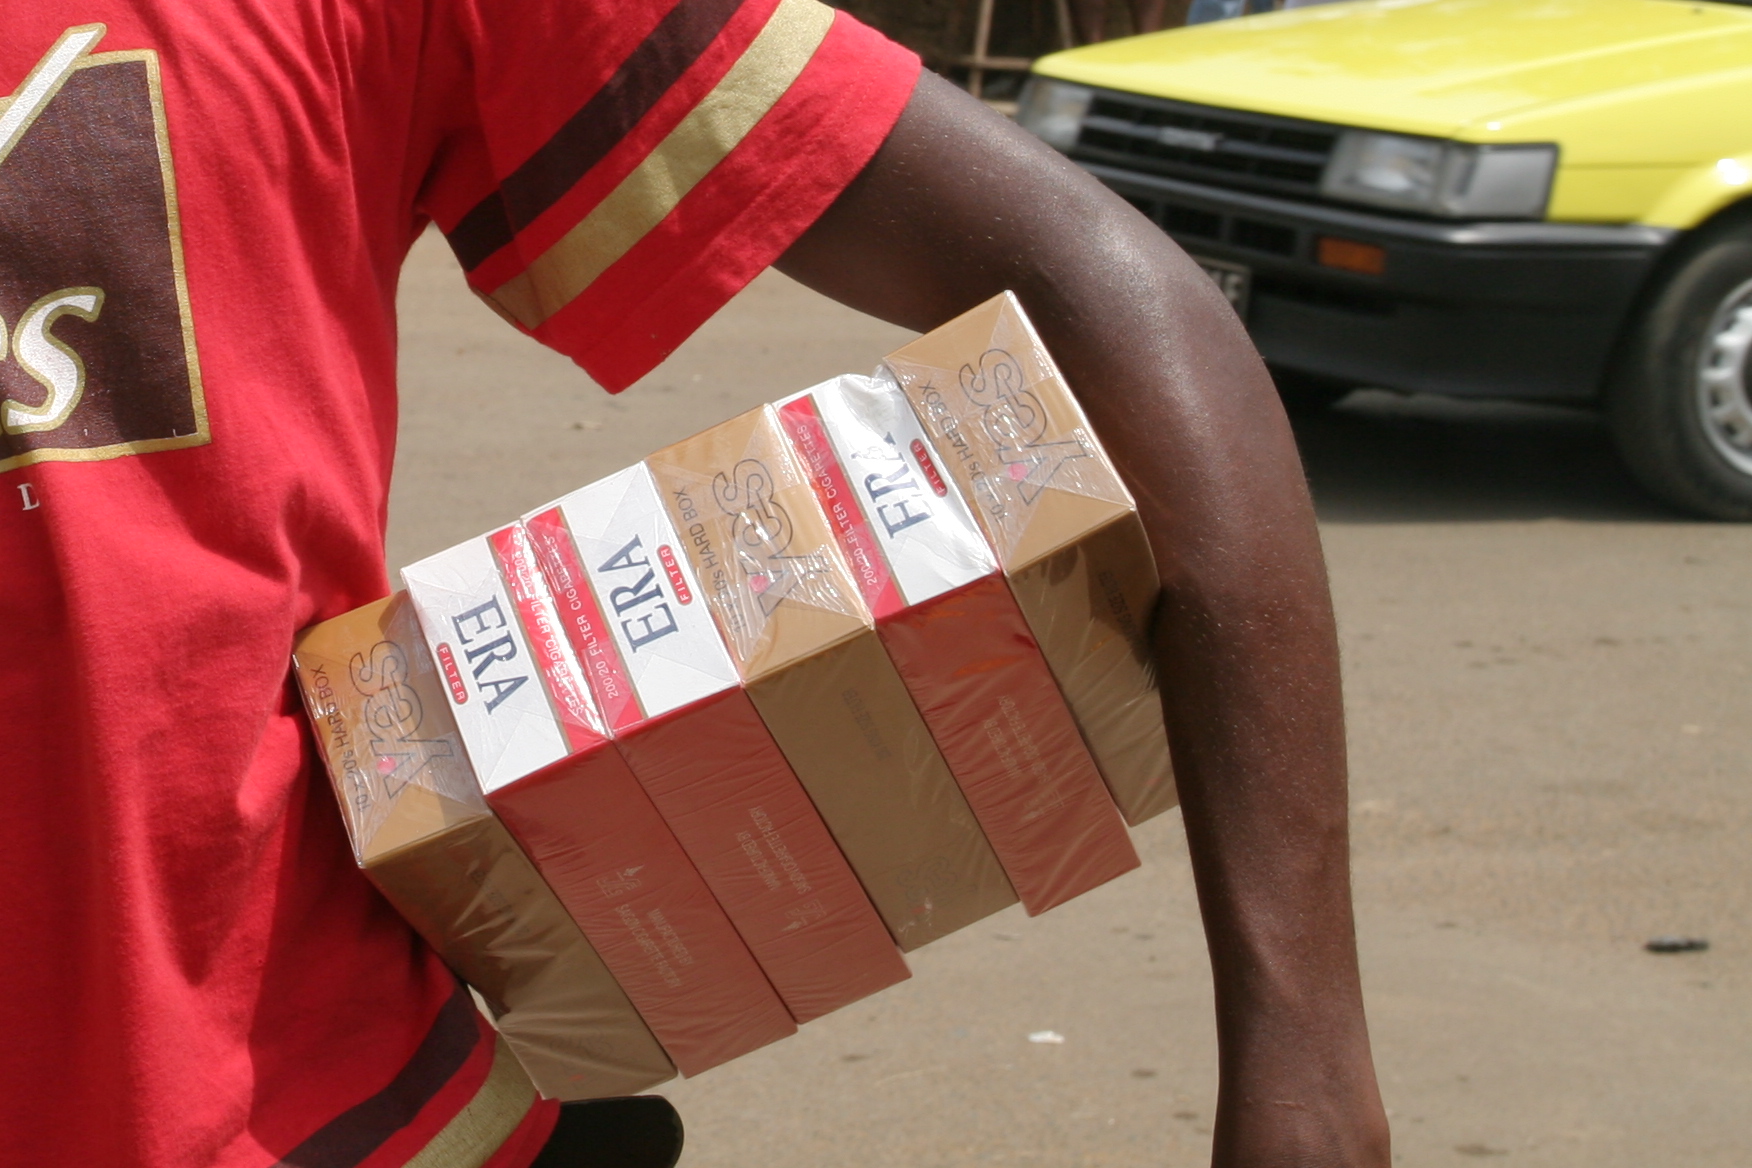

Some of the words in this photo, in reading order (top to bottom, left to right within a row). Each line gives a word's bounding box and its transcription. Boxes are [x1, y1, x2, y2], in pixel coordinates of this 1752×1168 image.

[795, 422, 838, 500] CIGARETTES
[914, 443, 946, 495] FILTER
[672, 486, 698, 521] BOX
[831, 501, 858, 544] FILTER
[687, 521, 719, 569] HARD
[598, 533, 679, 653] ERA
[661, 548, 691, 603] FILTER
[451, 595, 529, 715] ERA
[575, 613, 602, 656] FILTER
[310, 663, 333, 699] BOX
[439, 646, 466, 703] FILTER
[594, 658, 620, 699] 200/20
[323, 701, 349, 747] HARD
